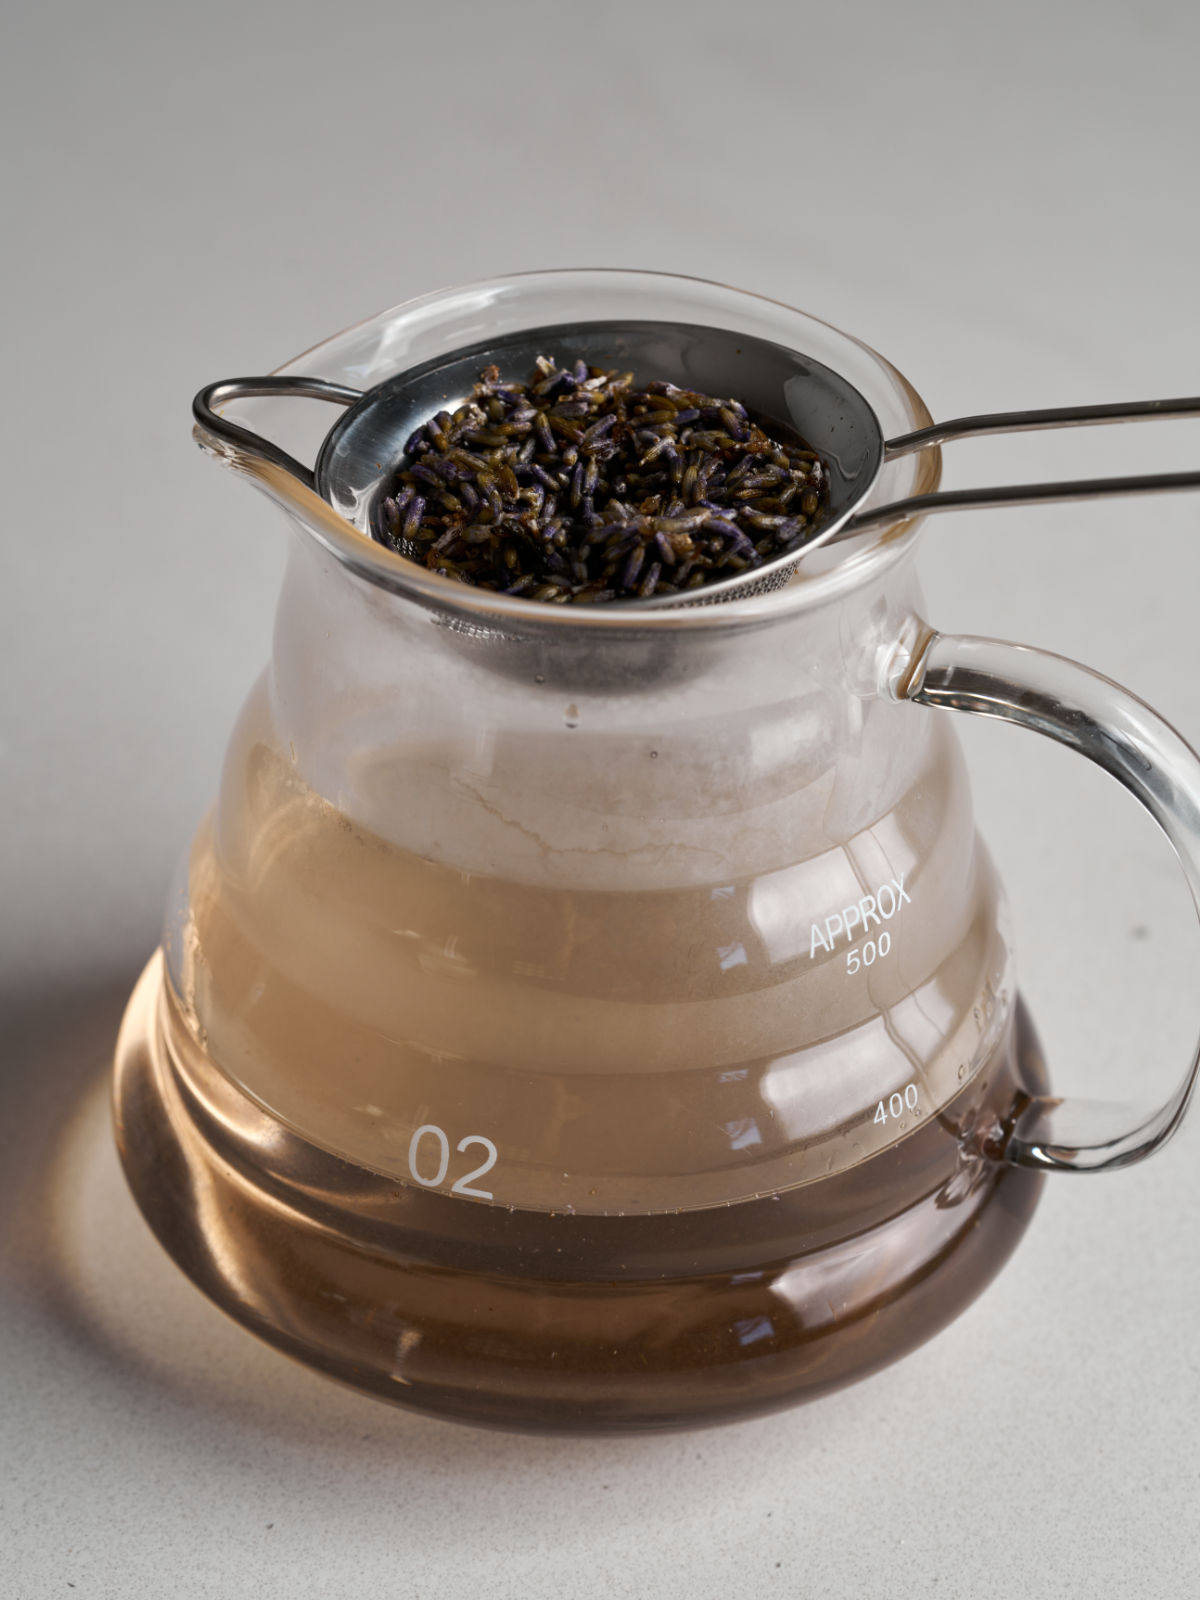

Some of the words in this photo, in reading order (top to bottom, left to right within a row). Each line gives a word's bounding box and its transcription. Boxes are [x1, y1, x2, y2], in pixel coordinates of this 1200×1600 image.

[809, 872, 911, 959] APPROX
[846, 931, 891, 975] 500
[873, 1083, 918, 1125] 400
[408, 1124, 498, 1200] 02
